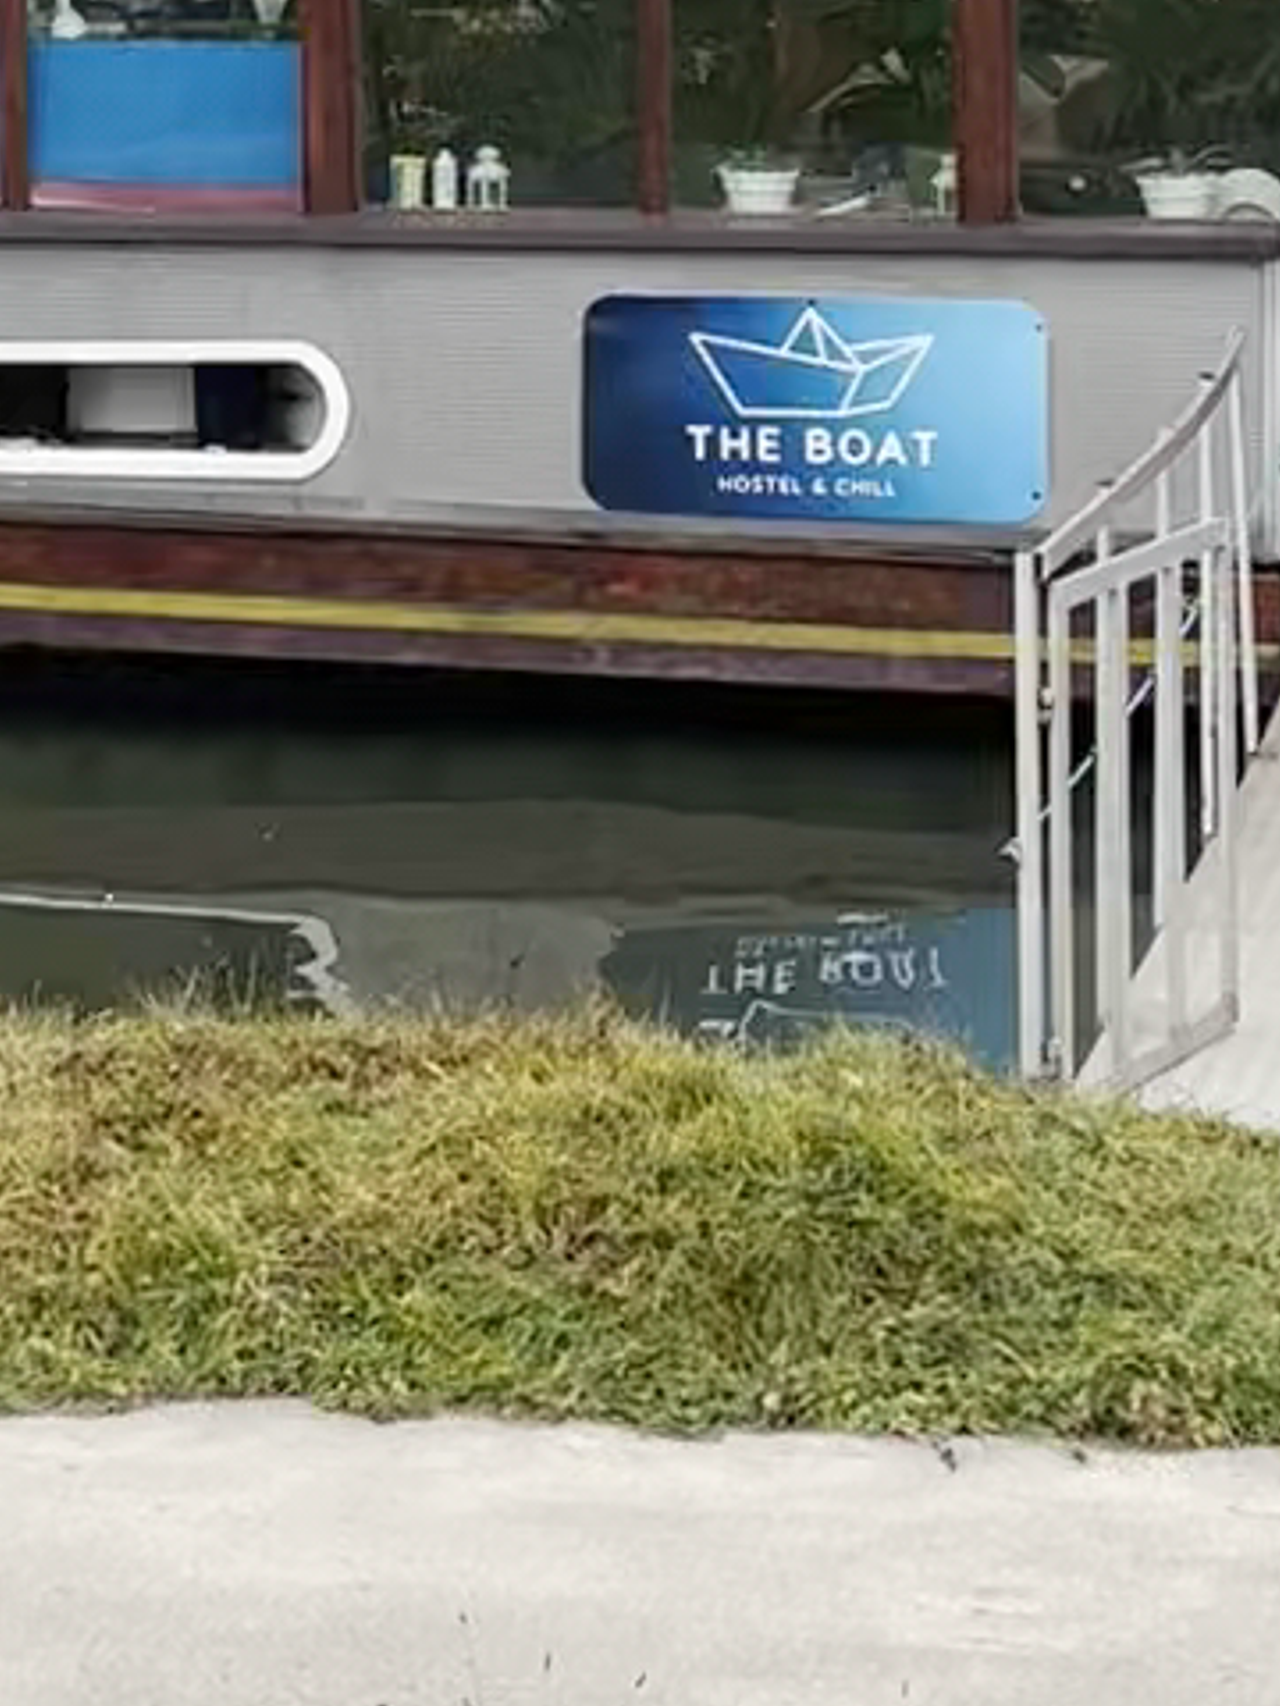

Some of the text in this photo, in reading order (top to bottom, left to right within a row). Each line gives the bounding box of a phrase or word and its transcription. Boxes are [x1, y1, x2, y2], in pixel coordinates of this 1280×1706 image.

[686, 424, 938, 468] THE BOAT
[717, 475, 897, 498] HOSTEL & CHILL
